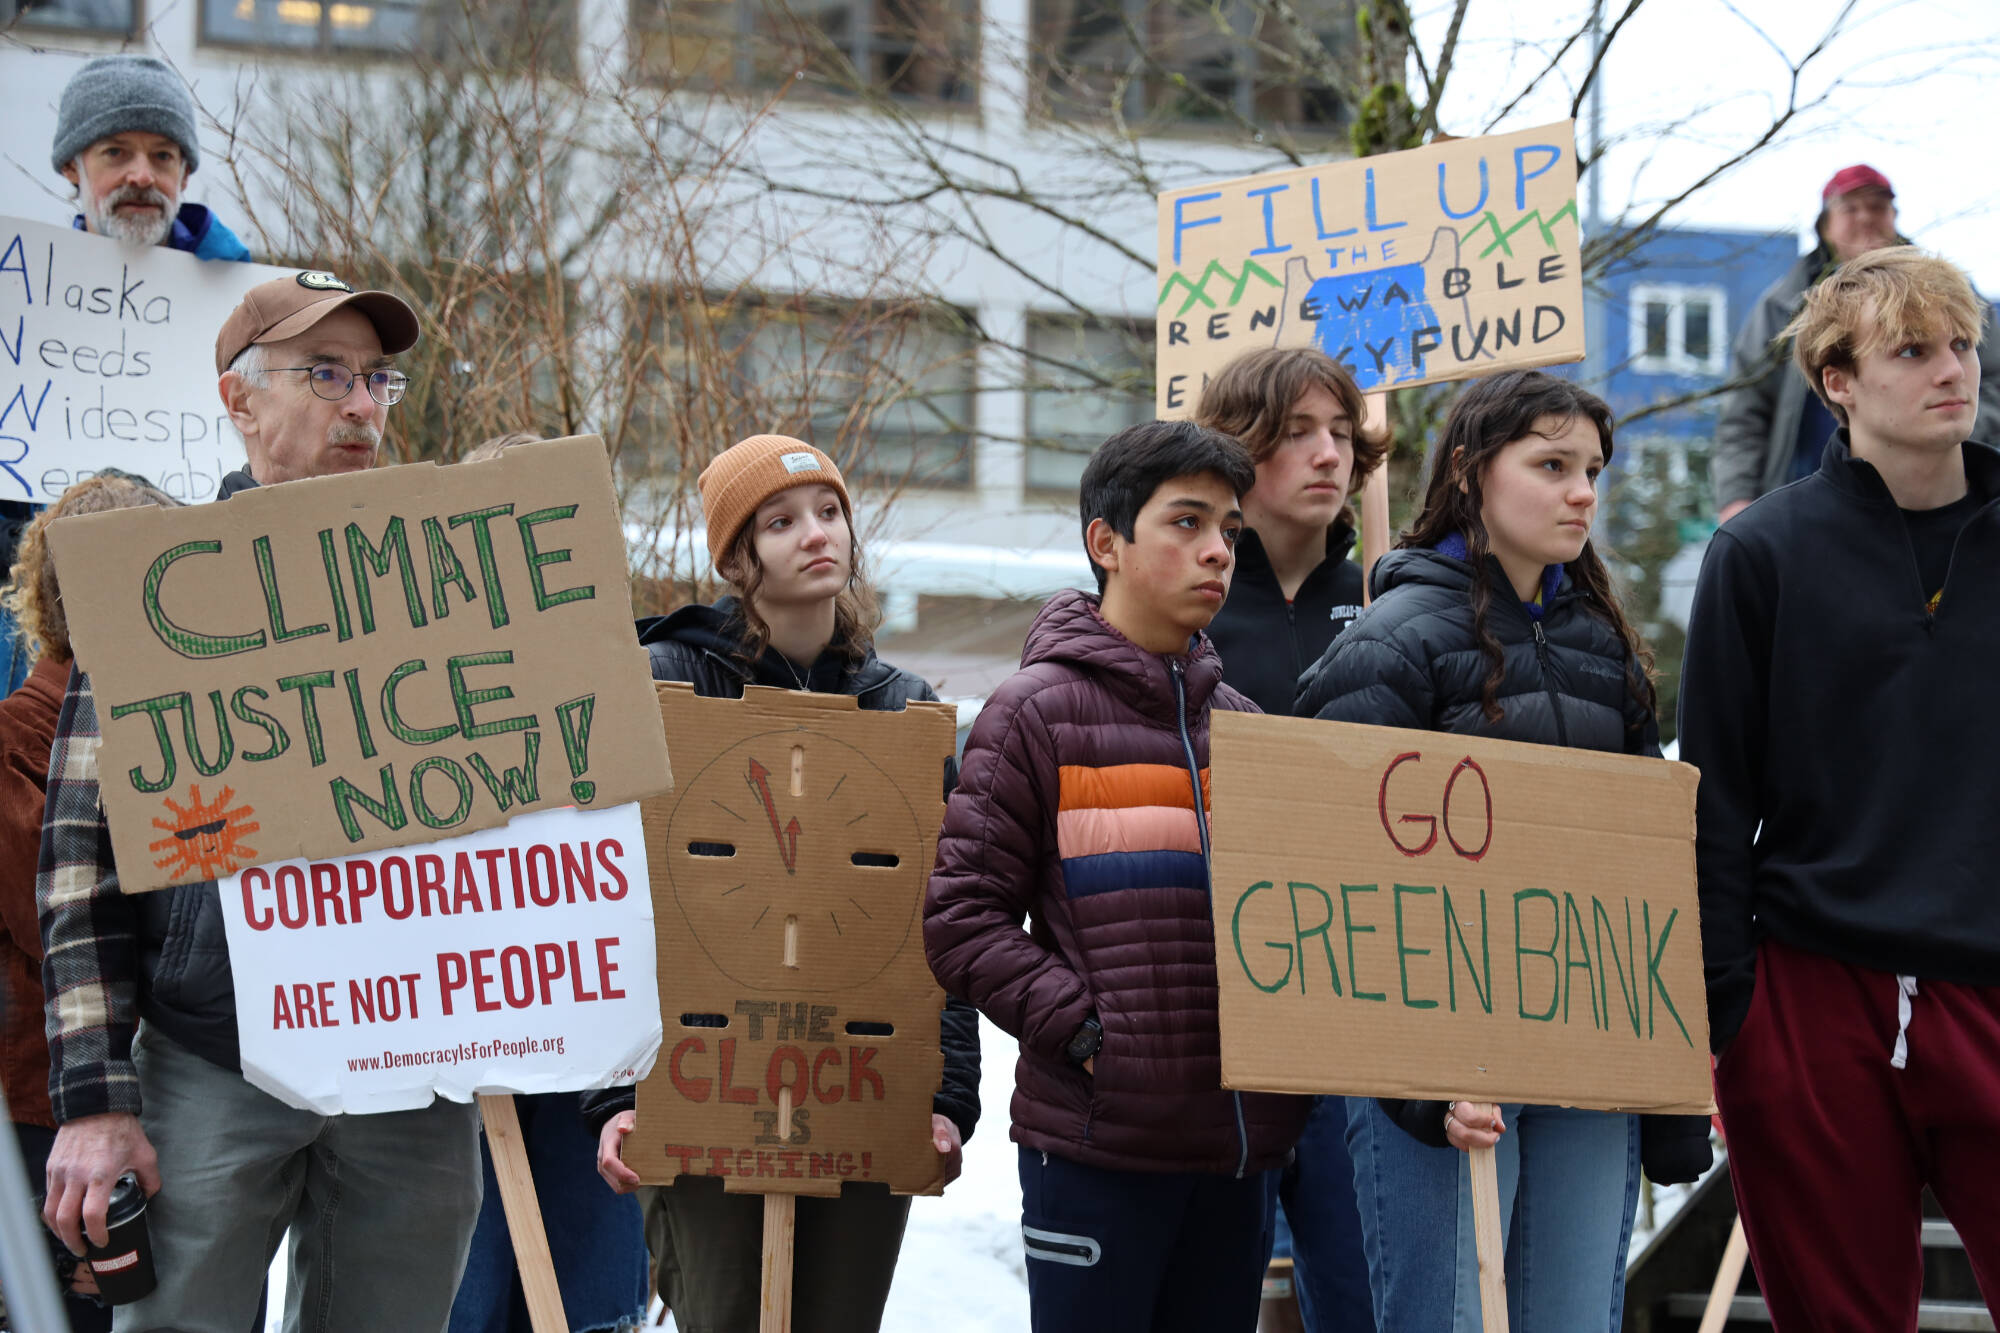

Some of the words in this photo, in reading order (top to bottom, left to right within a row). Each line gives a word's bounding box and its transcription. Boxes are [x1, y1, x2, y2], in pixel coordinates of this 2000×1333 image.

[1173, 167, 1408, 266] FILL
[1437, 144, 1562, 221] UP
[0, 233, 171, 325] Alaska
[1168, 254, 1566, 346] RENEWABLE
[1325, 239, 1398, 269] THE
[1411, 305, 1566, 370] FUND
[142, 503, 596, 660] CLIMATE
[111, 650, 539, 794] JUSTICE
[330, 694, 596, 843] NOW!
[1378, 751, 1493, 862] GO
[240, 838, 629, 932] CORPORATIONS
[272, 981, 340, 1031] ARE
[348, 973, 422, 1025] NOT
[436, 936, 626, 1016] PEOPLE
[1231, 880, 1493, 1015] GREEN
[1513, 888, 1695, 1048] BANK
[347, 1036, 565, 1073] www.DemocracyIsForPeople.org
[734, 999, 838, 1043] THE
[668, 1036, 886, 1108] CLOCK
[664, 1143, 872, 1179] TICKING!
[753, 1107, 812, 1146] IS
